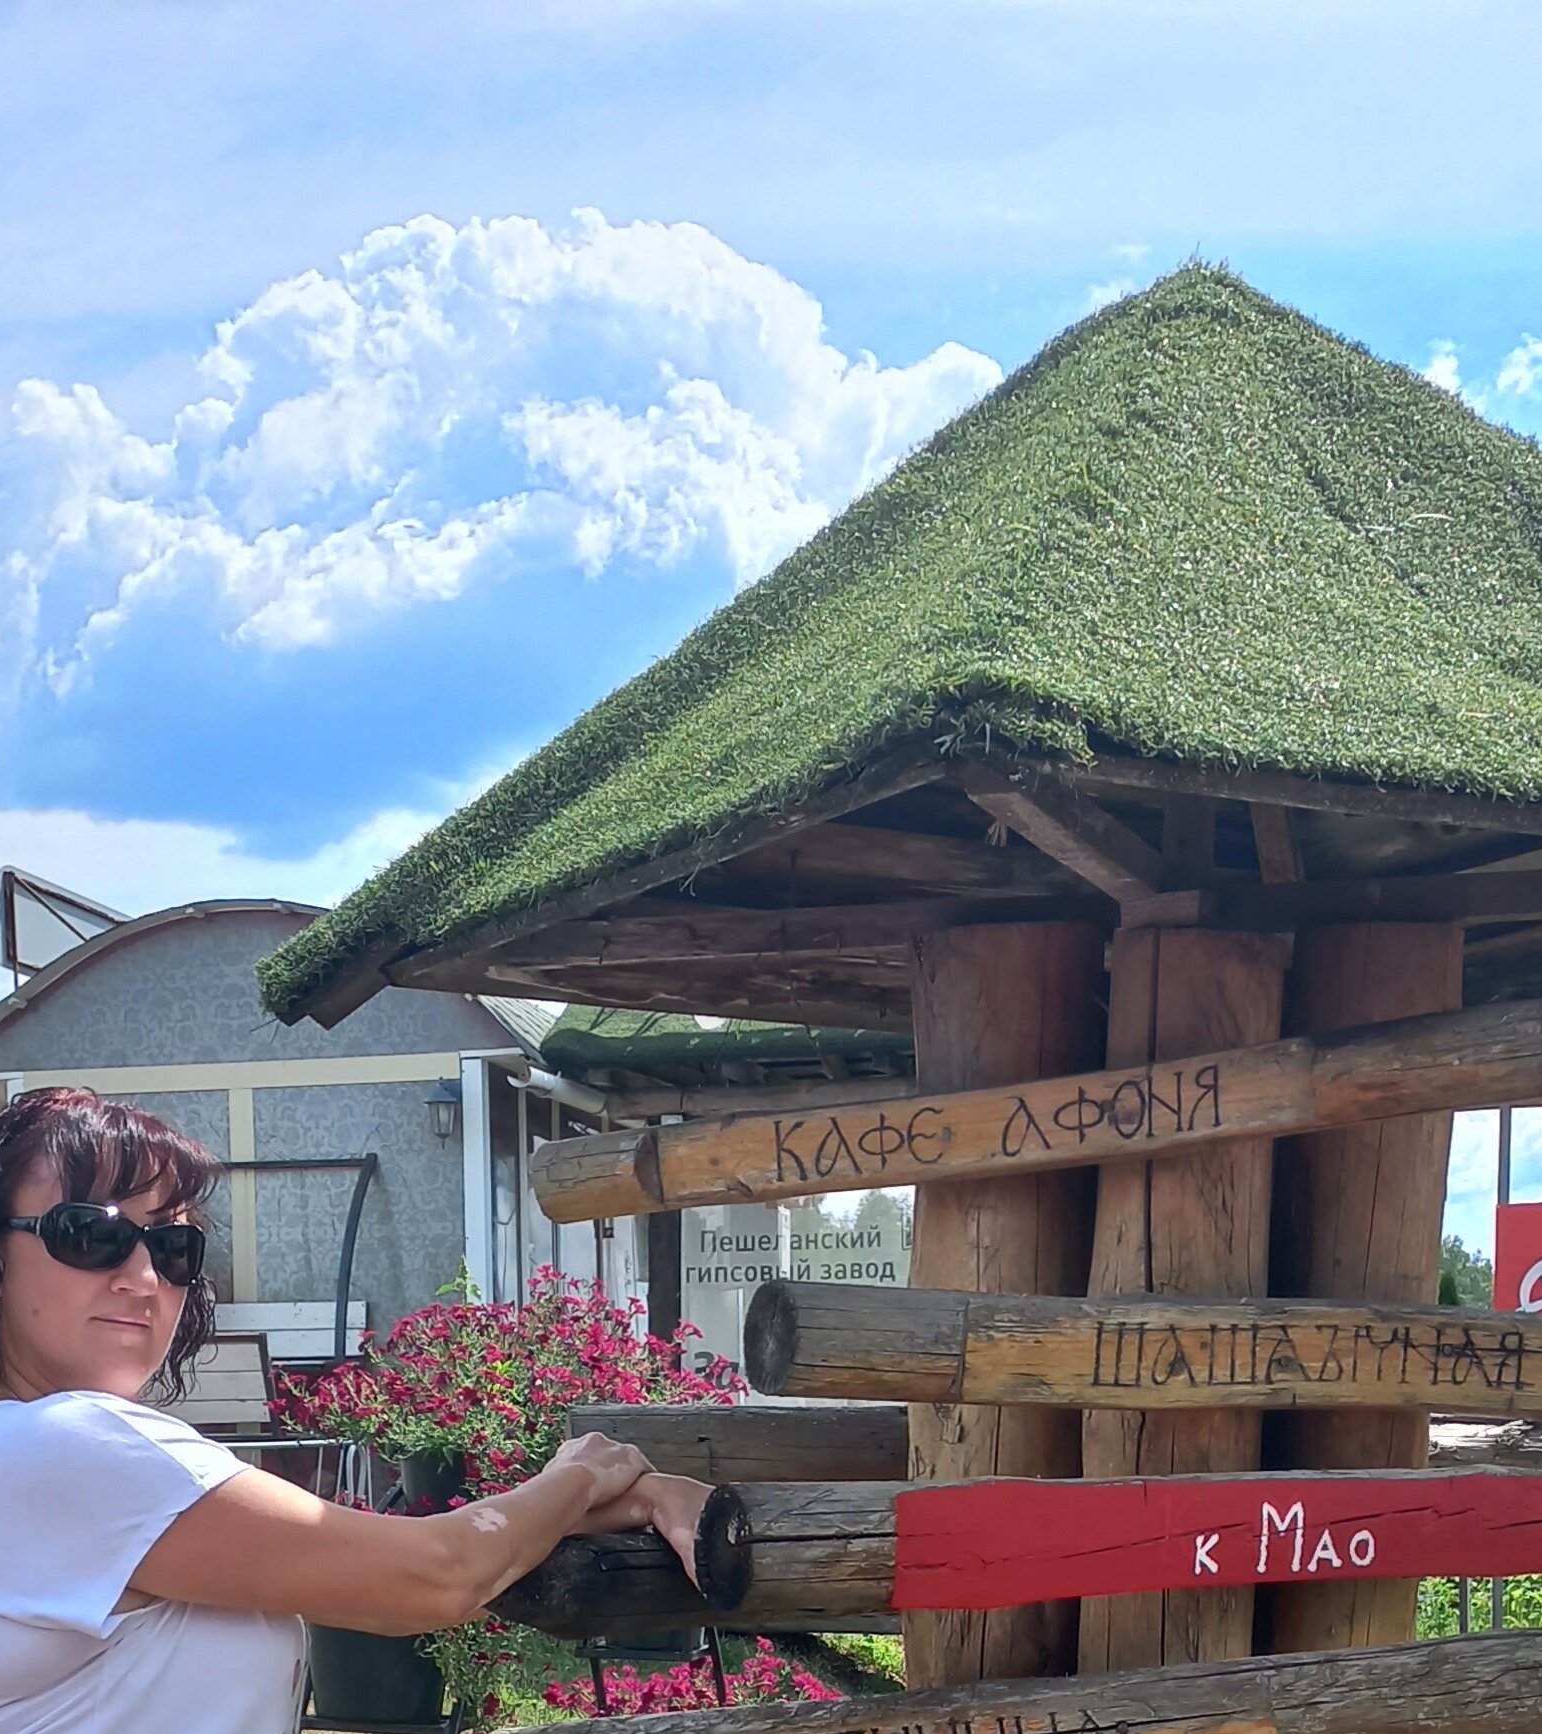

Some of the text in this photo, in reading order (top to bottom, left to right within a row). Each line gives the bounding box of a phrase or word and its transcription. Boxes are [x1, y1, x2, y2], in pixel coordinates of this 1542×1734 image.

[773, 1063, 1222, 1182] КАФЕ АФОНЯ
[686, 1258, 897, 1284] гипсовый завод
